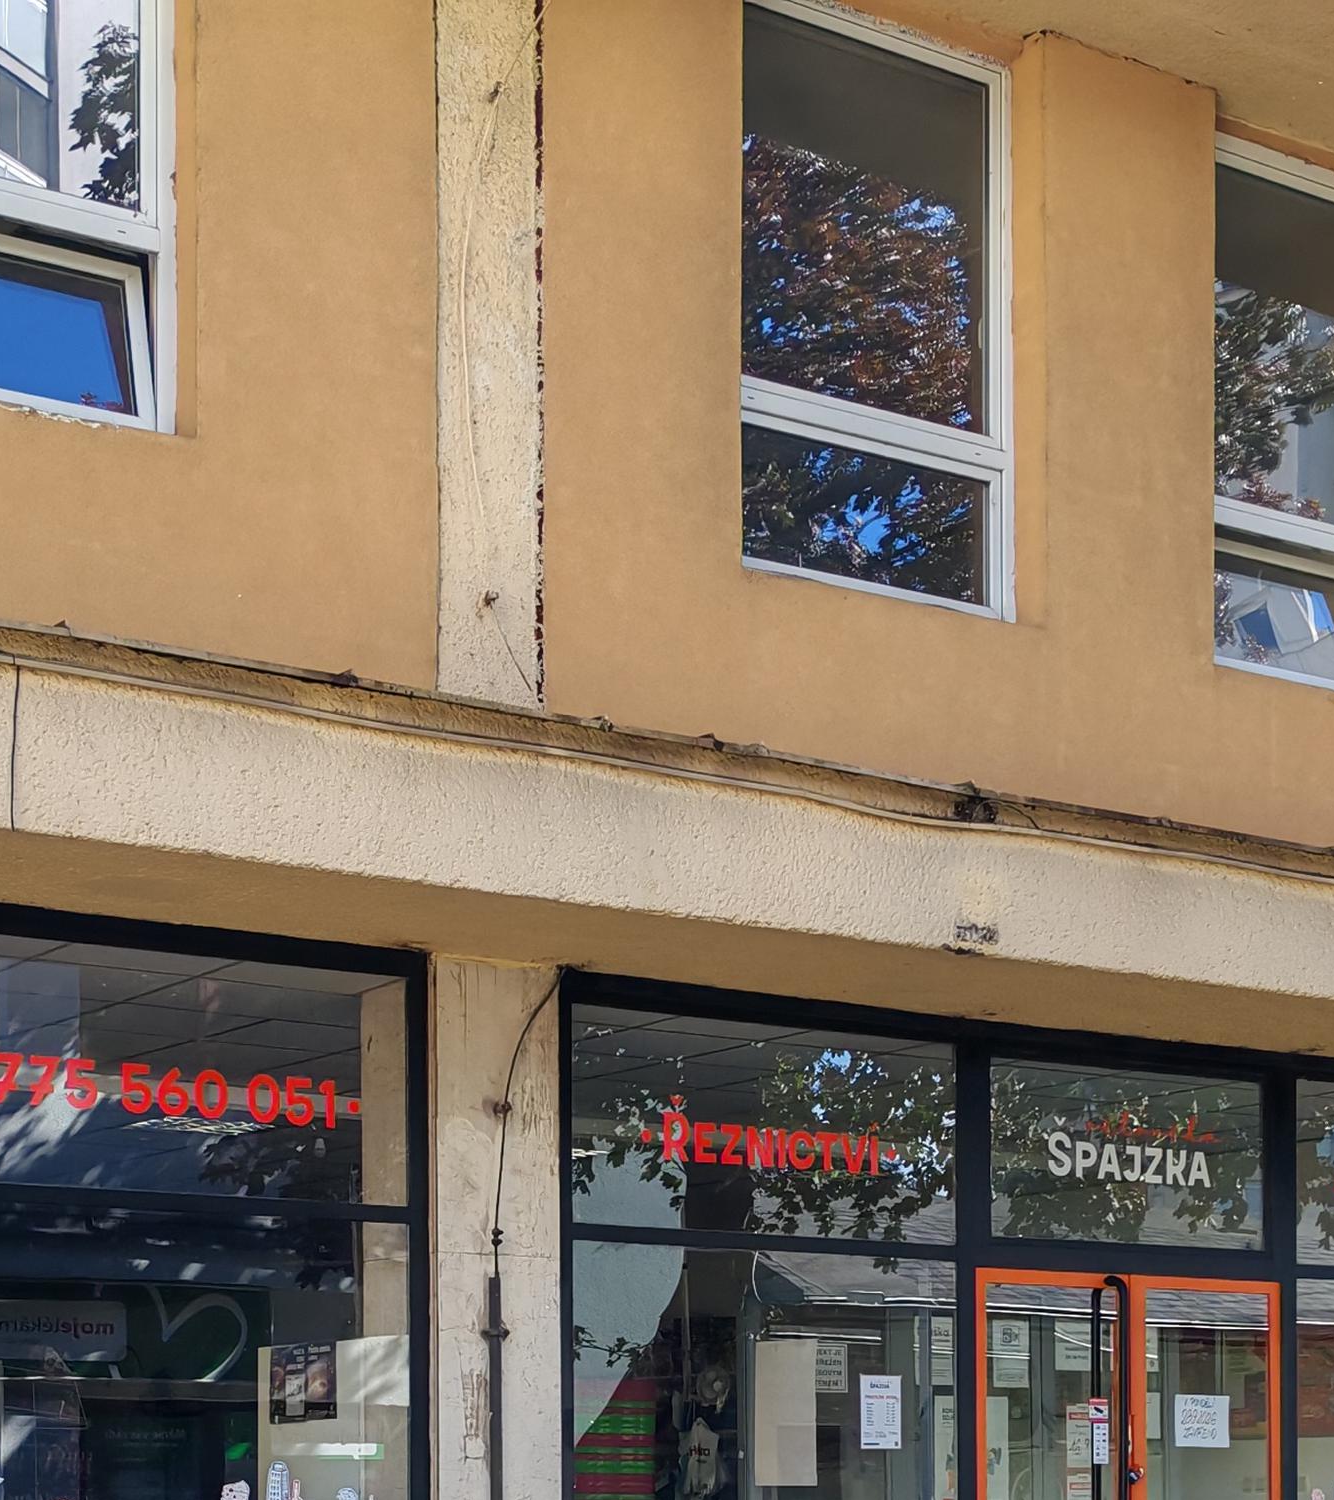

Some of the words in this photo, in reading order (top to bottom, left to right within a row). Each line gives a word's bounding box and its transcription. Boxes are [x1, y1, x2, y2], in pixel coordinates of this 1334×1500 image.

[120, 1061, 229, 1120] 560
[248, 1073, 337, 1129] 051
[663, 1094, 880, 1176] ŘEZNICTVÍ
[1047, 1116, 1212, 1188] ŠPAJZKA
